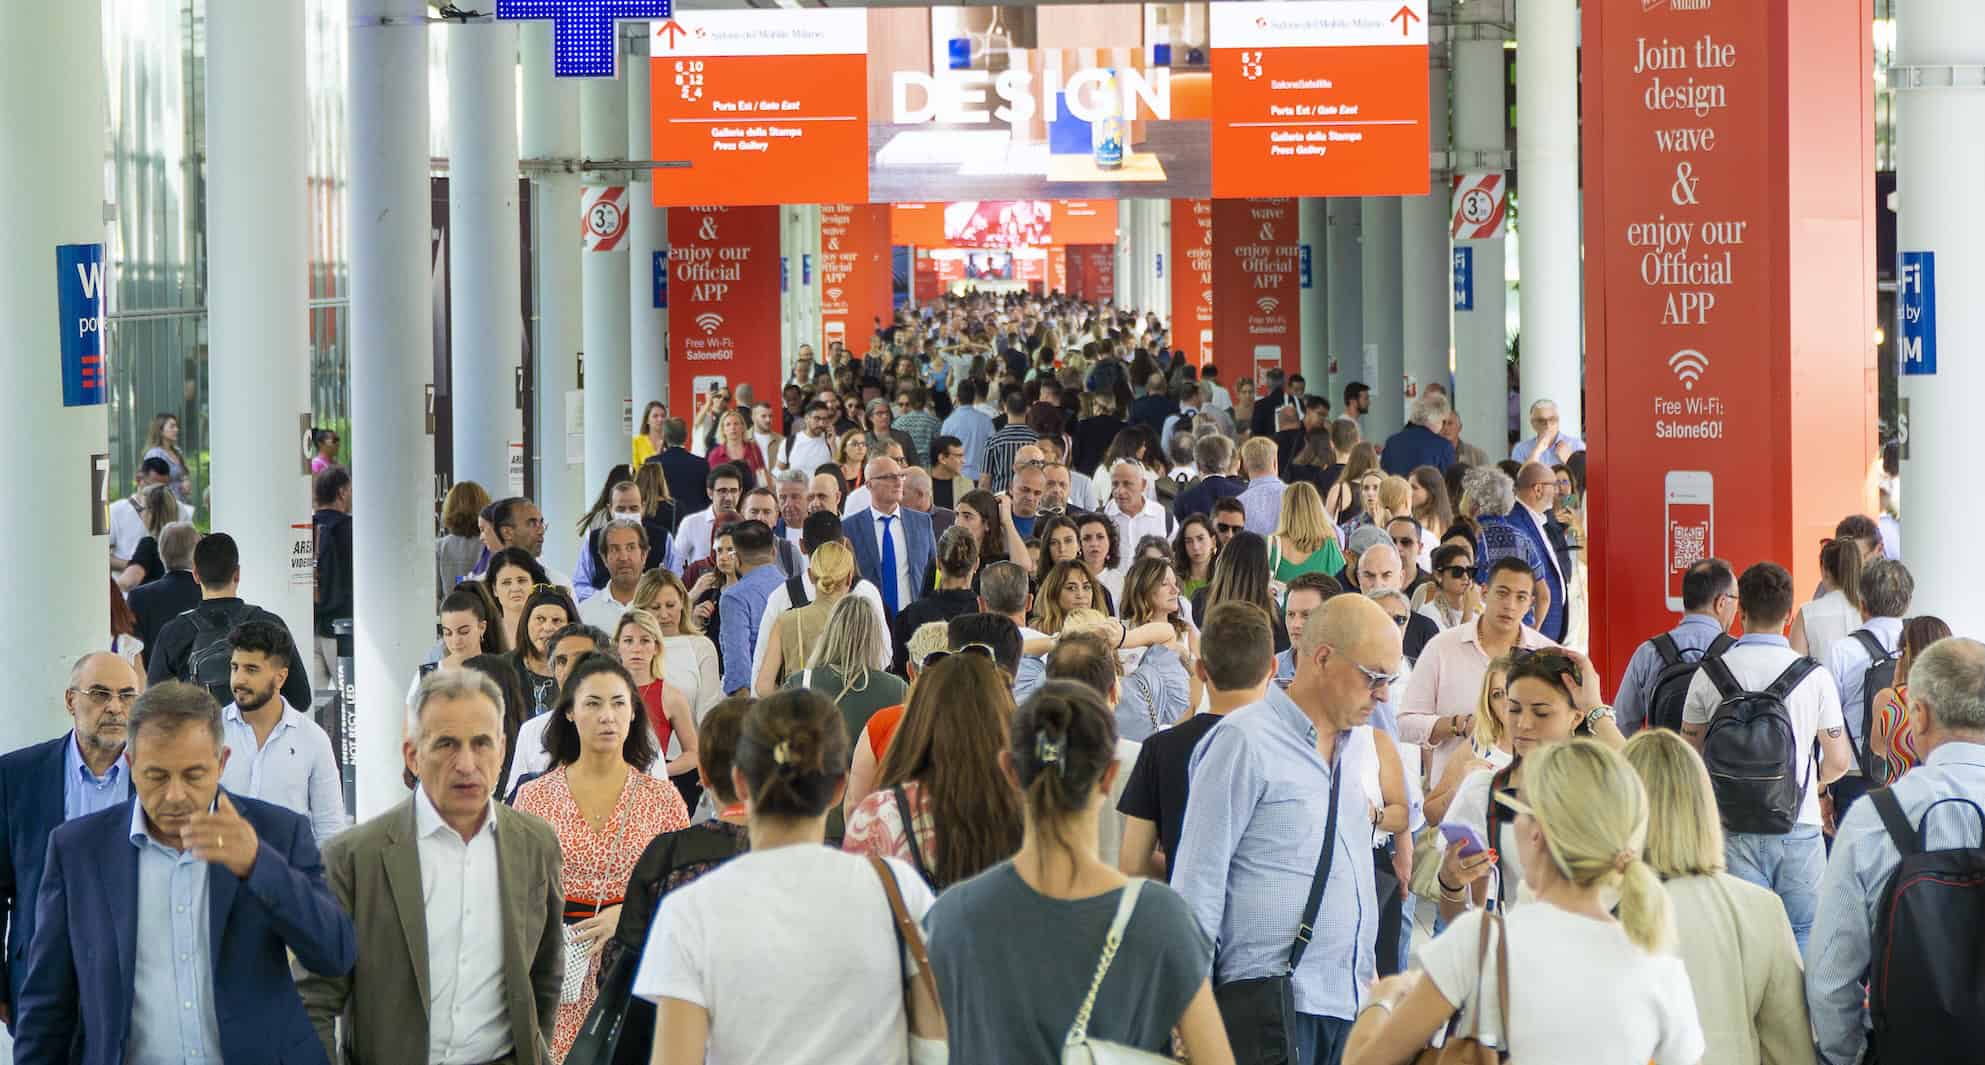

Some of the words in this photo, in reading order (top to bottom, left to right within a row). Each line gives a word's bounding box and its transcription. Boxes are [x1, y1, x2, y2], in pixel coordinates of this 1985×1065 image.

[1633, 36, 1687, 73] Join
[1695, 34, 1736, 68] the
[893, 67, 1170, 123] DESIGN
[1644, 76, 1727, 117] design
[713, 101, 736, 111] Porta
[1271, 105, 1294, 115] Porta
[1655, 127, 1715, 152] wave
[1671, 161, 1699, 205] &
[1468, 197, 1477, 215] 3
[595, 209, 605, 228] 3
[699, 216, 720, 240] &
[1260, 222, 1274, 240] &
[1627, 213, 1695, 254] enjoy
[1701, 221, 1747, 245] our
[668, 243, 714, 266] enjoy
[720, 247, 751, 260] our
[678, 262, 740, 281] Official
[1242, 259, 1293, 273] Official
[1641, 250, 1733, 286] Official
[690, 284, 728, 302] APP
[1661, 291, 1716, 325] APP
[1655, 397, 1681, 415] Free
[1685, 397, 1724, 415] Wi-Fi:
[1656, 420, 1723, 439] Salone60!
